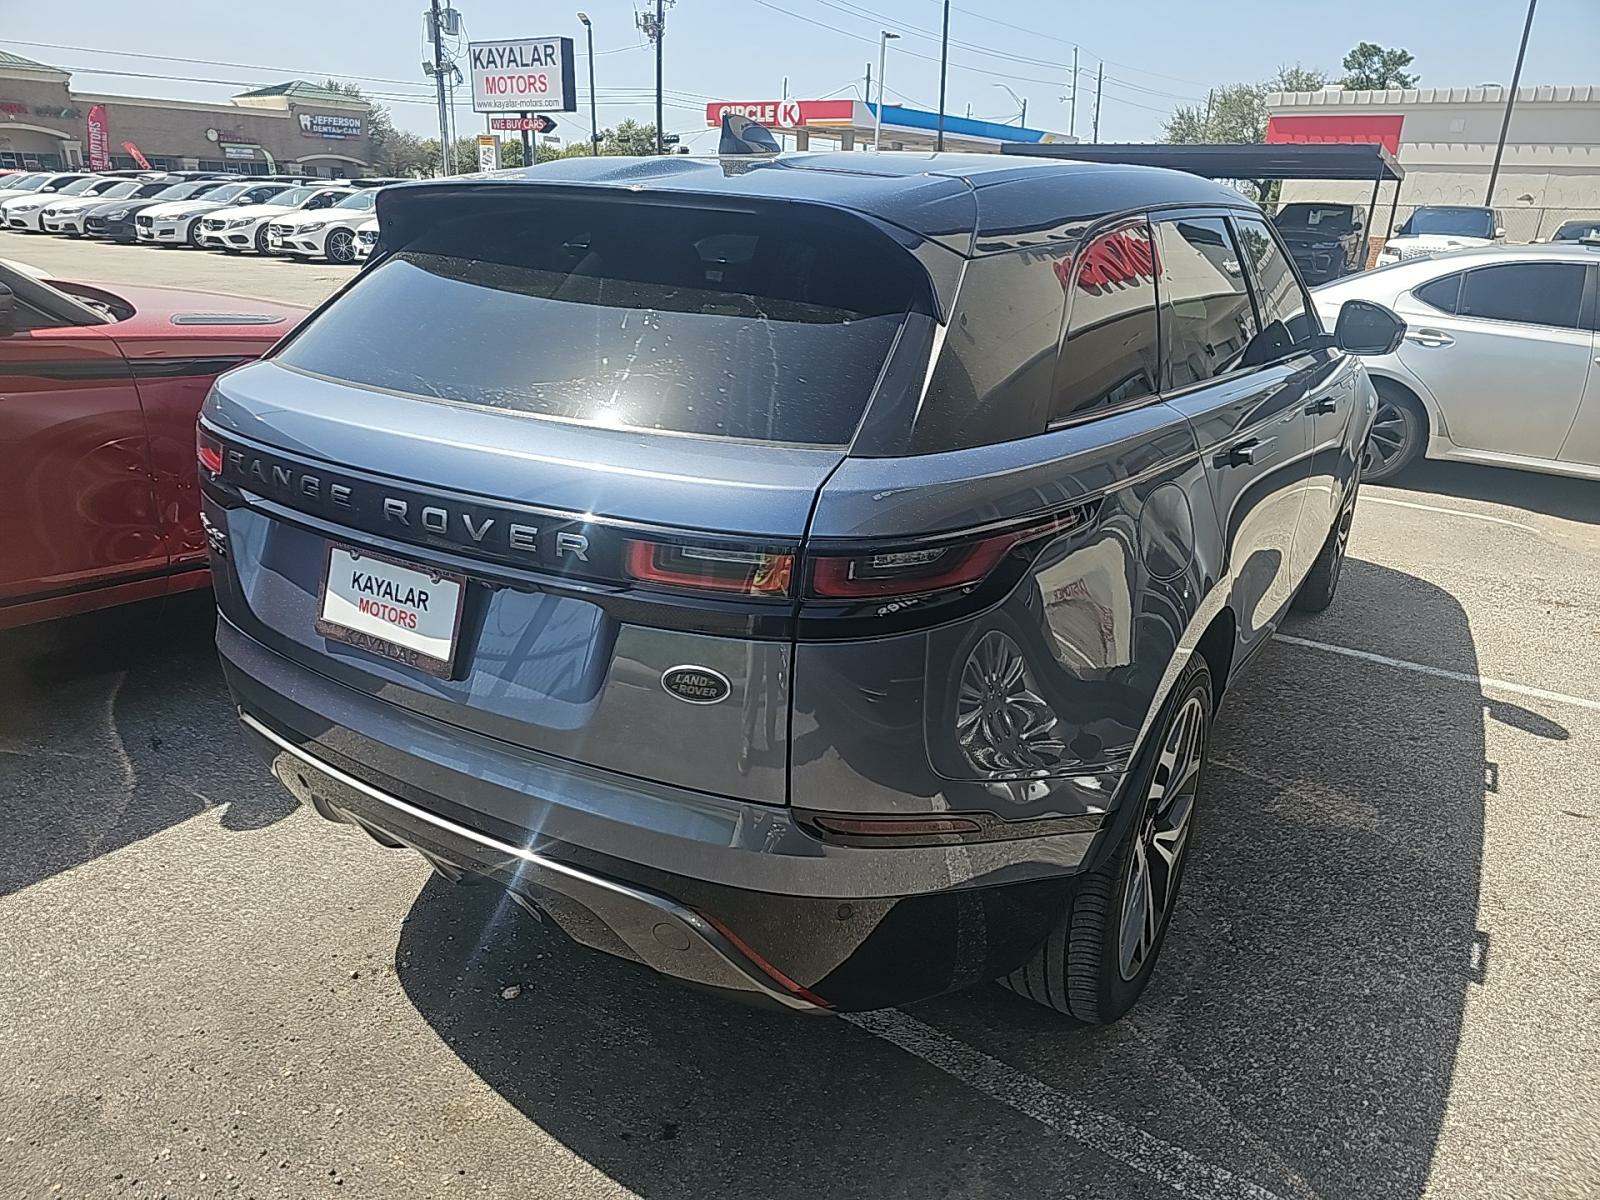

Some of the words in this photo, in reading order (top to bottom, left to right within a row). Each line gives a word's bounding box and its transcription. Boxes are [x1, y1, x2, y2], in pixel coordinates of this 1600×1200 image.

[472, 44, 557, 69] KAYALAR
[485, 74, 548, 94] MOTORS
[477, 98, 560, 109] www.kayalar-motors.com
[312, 115, 361, 127] JEFFERSON
[492, 119, 505, 129] WE
[506, 119, 522, 129] BUY
[523, 118, 544, 129] CARS
[782, 103, 797, 127] K
[313, 125, 340, 134] DENTAL
[226, 449, 352, 508] RANGE
[383, 497, 591, 562] ROVER
[351, 570, 430, 612] KAYALAR
[358, 597, 418, 630] MOTORS
[675, 673, 708, 687] LAND
[678, 684, 718, 697] ROVER
